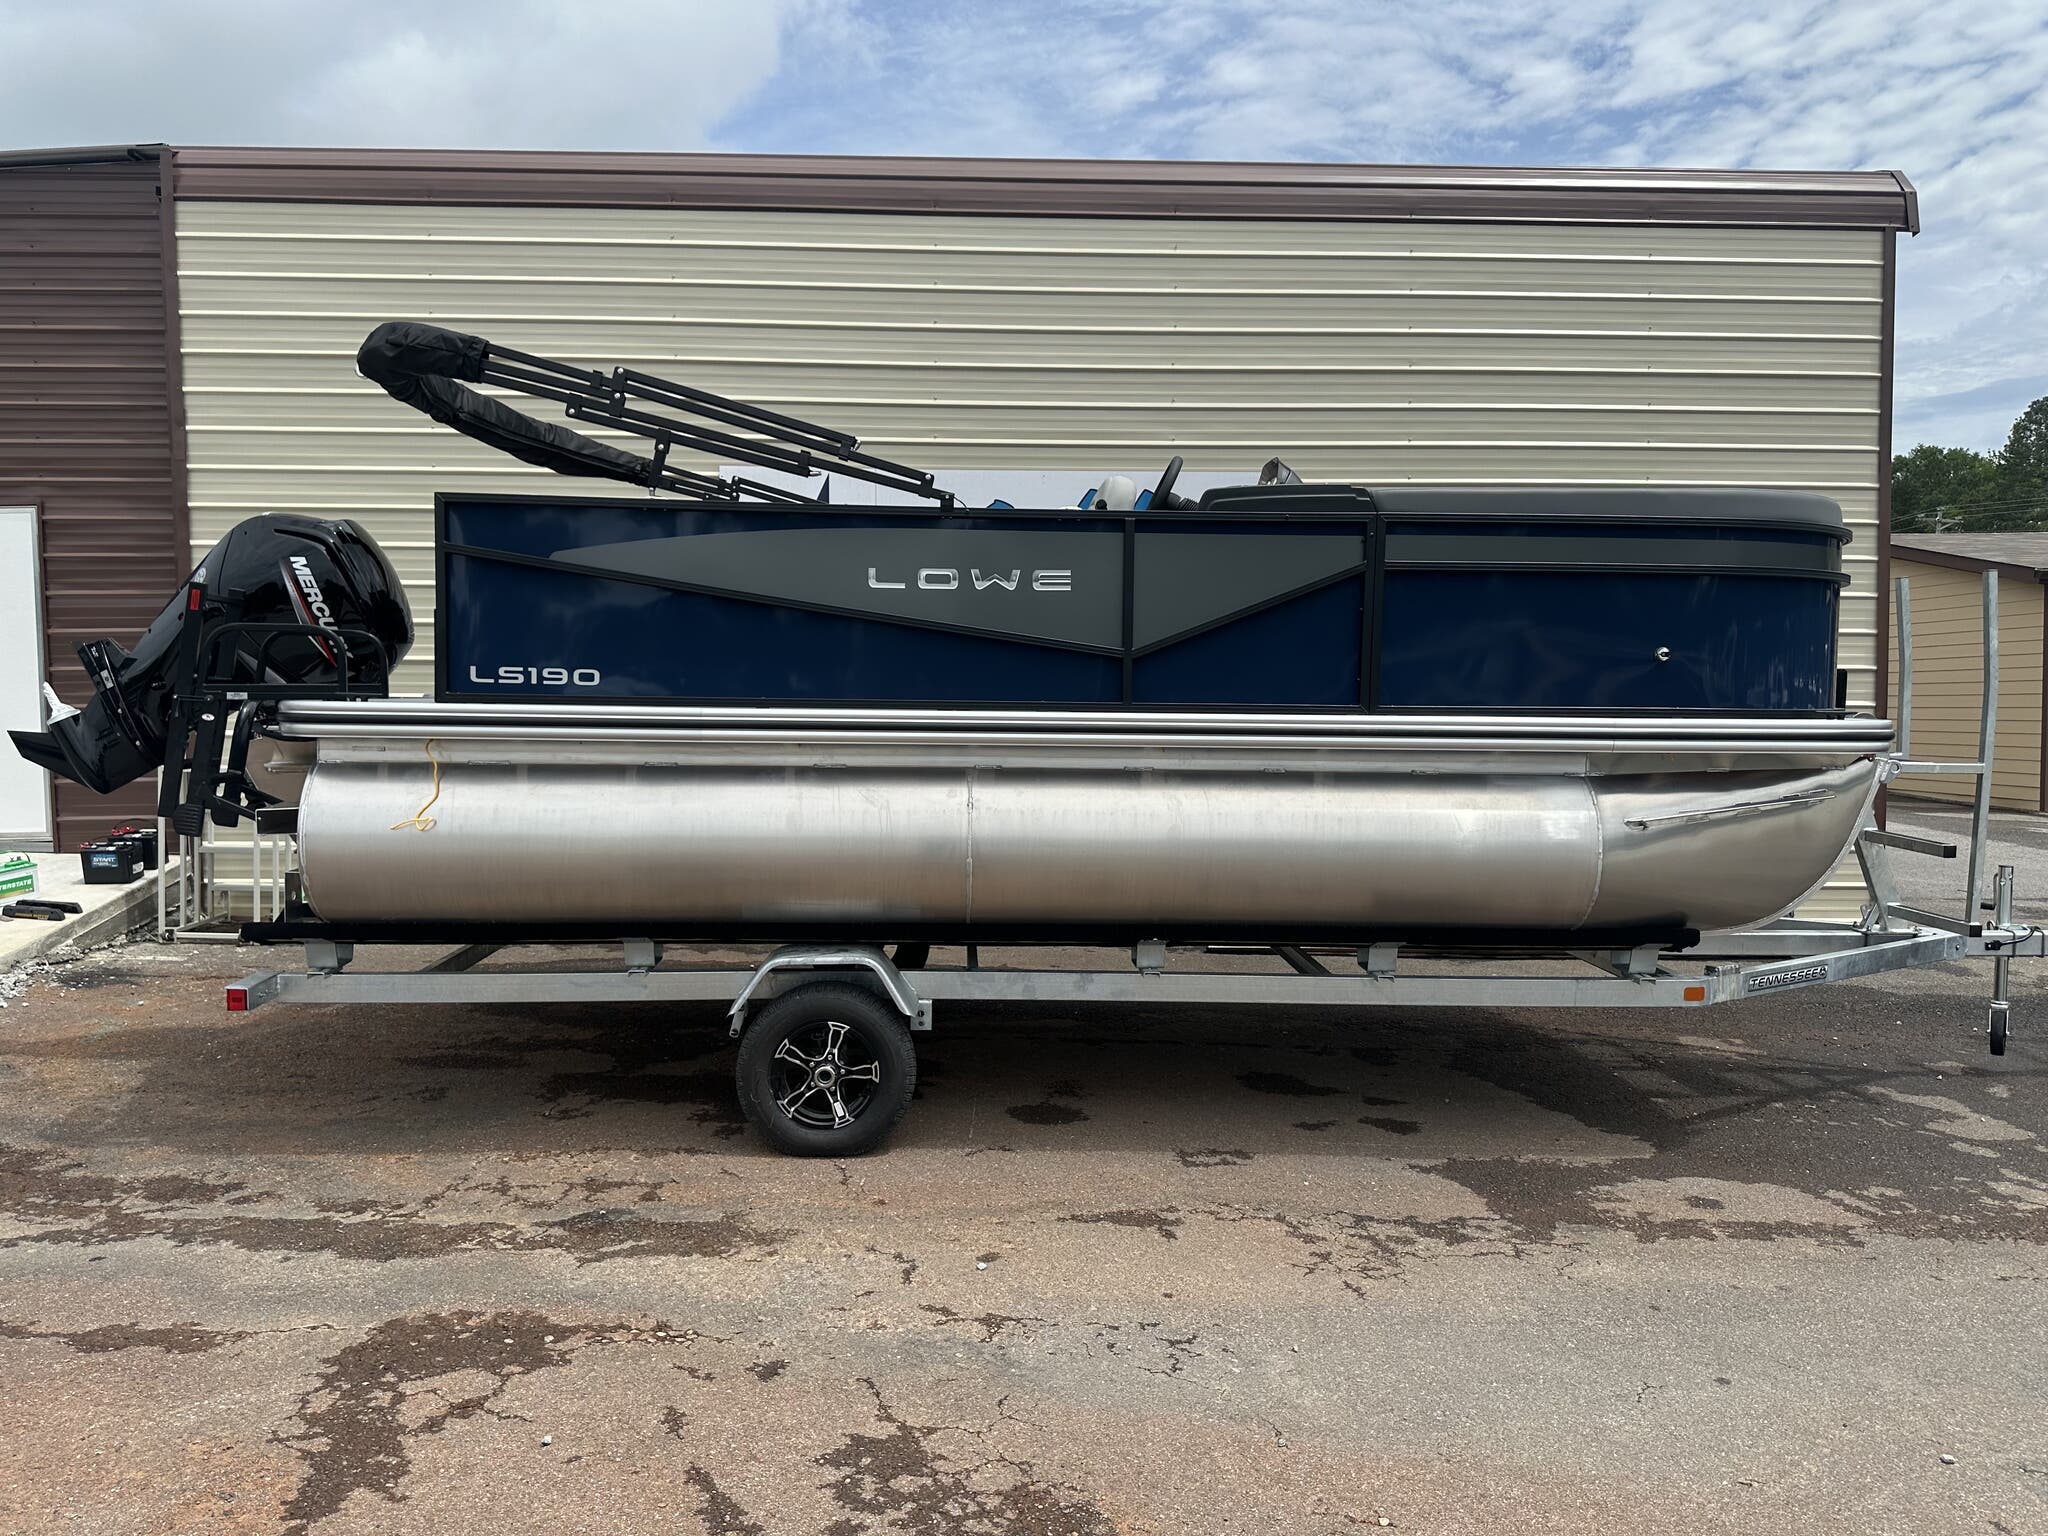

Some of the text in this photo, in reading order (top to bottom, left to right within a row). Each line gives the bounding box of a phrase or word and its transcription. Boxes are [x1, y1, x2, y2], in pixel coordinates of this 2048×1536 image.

[868, 567, 1072, 591] LOWE
[469, 665, 601, 686] LS190
[1751, 967, 1818, 989] TENNESSEE
